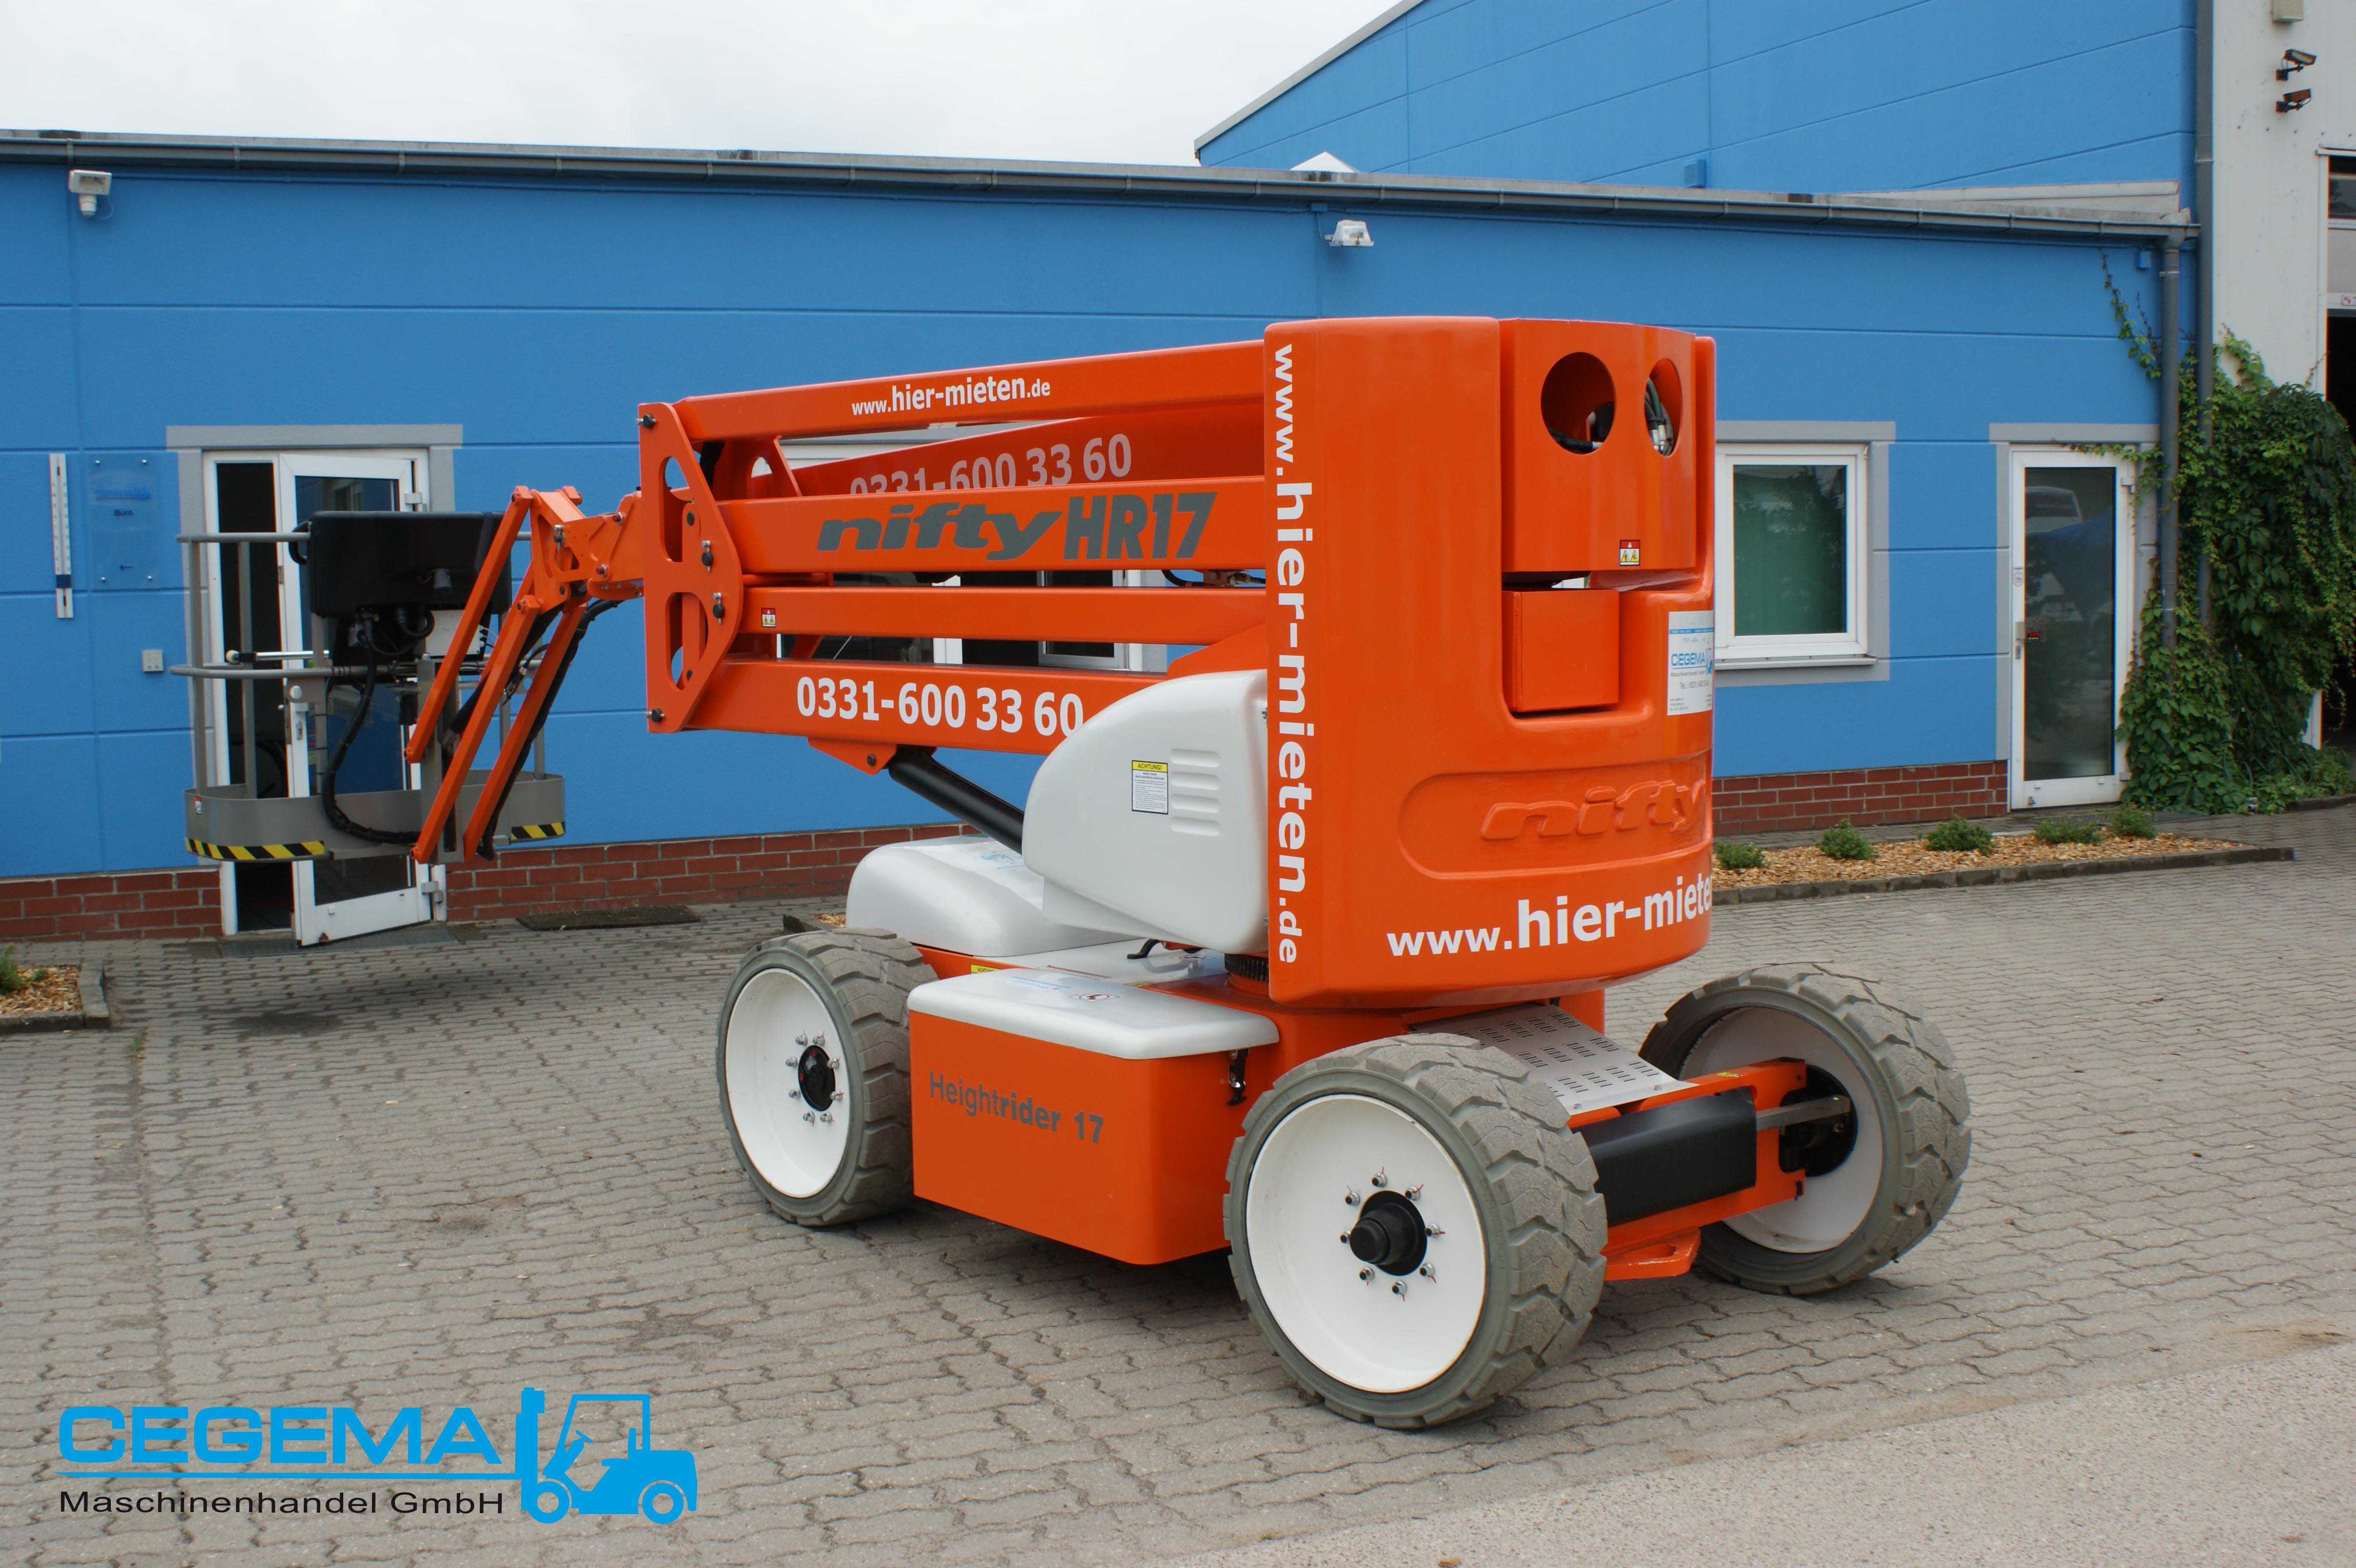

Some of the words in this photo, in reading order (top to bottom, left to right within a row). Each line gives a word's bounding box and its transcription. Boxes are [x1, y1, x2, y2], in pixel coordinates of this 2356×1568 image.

[852, 376, 1051, 416] www.hier-mieten.de
[1026, 444, 1072, 486] 33
[1083, 434, 1131, 481] 60
[817, 502, 1065, 561] nifty
[1064, 492, 1218, 560] HR17
[1275, 343, 1314, 963] www.hier-mieten.de
[1672, 652, 1705, 666] CEGEMA
[797, 677, 966, 728] 0331-600
[976, 687, 1023, 733] 33
[1034, 692, 1084, 738] 60
[1481, 780, 1705, 840] nifty
[1387, 873, 1712, 956] www.hier-miete
[930, 1069, 1061, 1132] Heightrider
[1075, 1110, 1104, 1144] 17
